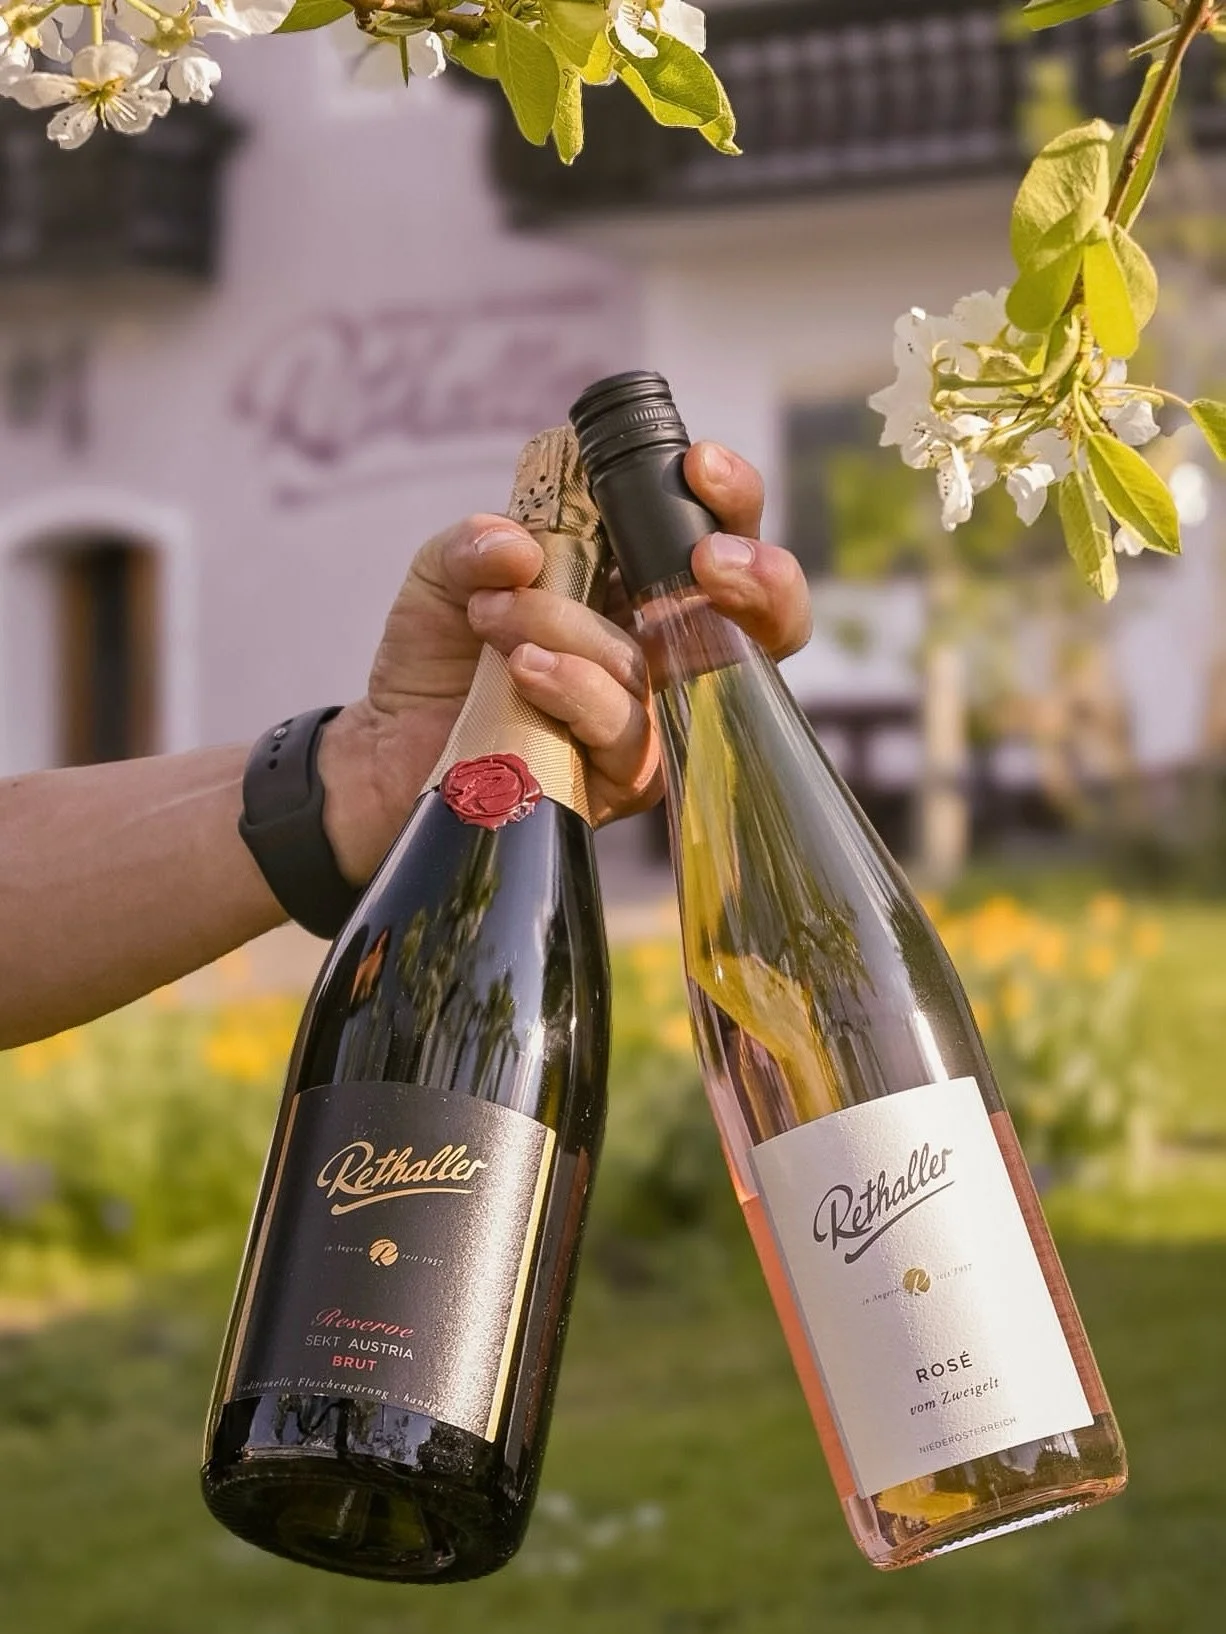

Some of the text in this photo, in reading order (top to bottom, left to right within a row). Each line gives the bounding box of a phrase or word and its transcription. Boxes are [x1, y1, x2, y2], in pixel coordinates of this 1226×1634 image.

[316, 1140, 489, 1199] Rethaller
[813, 1142, 953, 1251] Rethaller
[311, 1306, 416, 1339] Reserve
[304, 1333, 414, 1361] SEKT AUSTRIA
[331, 1354, 378, 1372] BRUT
[915, 1350, 973, 1384] ROSÉ
[297, 1376, 390, 1400] Flaschengärung
[909, 1376, 1000, 1416] vom Zweigelt
[919, 1416, 1018, 1454] NIEDERÖSTERREICH
